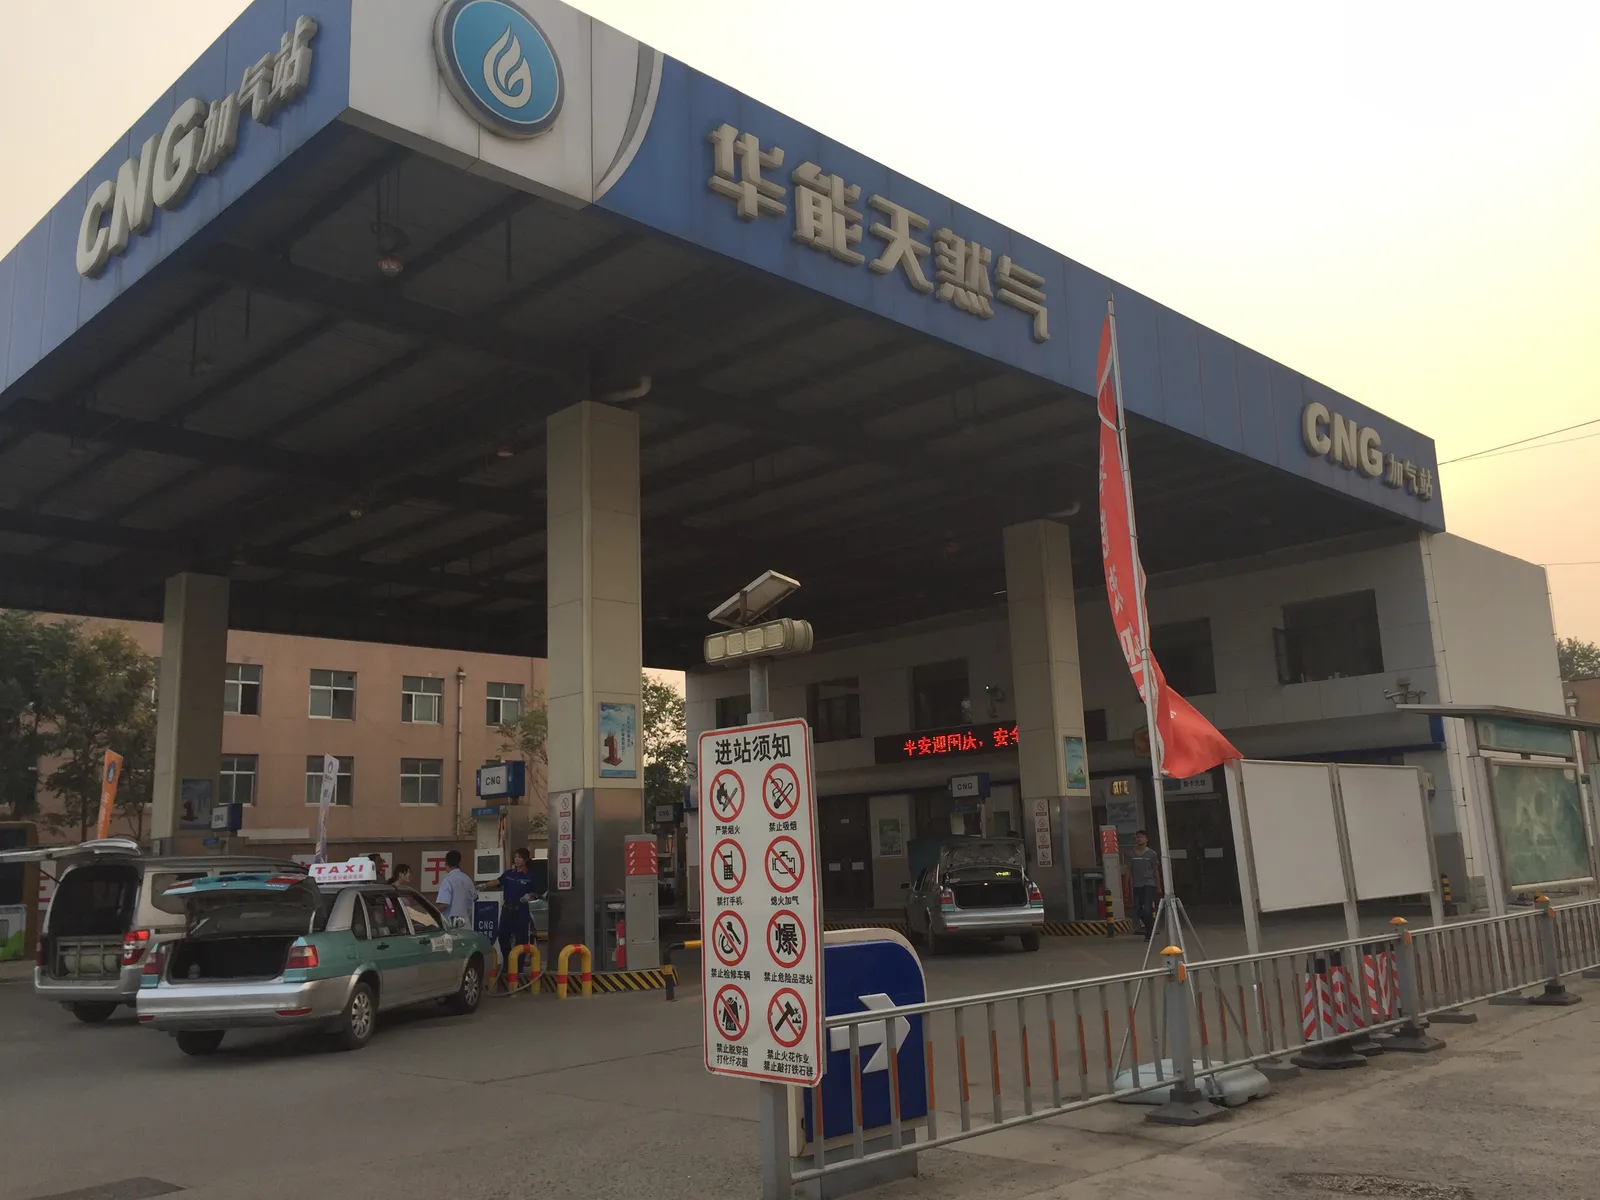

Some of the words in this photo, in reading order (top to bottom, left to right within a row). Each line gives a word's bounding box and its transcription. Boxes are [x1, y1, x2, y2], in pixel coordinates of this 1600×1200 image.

[708, 122, 1049, 344] 华能天然气
[715, 733, 791, 765] 进站须知
[486, 775, 501, 786] CNG
[957, 782, 974, 791] CNG
[715, 825, 740, 835] 严禁烟火
[768, 821, 797, 832] 禁止吸烟
[315, 864, 364, 874] TAXI
[717, 896, 743, 906] 禁打手机
[770, 896, 799, 906] 熄火加气
[478, 921, 494, 930] CNG
[775, 923, 798, 955] 爆
[710, 968, 751, 980] 禁止检修车辆
[763, 971, 813, 985] 禁止危险品进站
[716, 1054, 749, 1068] 打化纤衣服
[766, 1049, 809, 1064] 禁止火花作业
